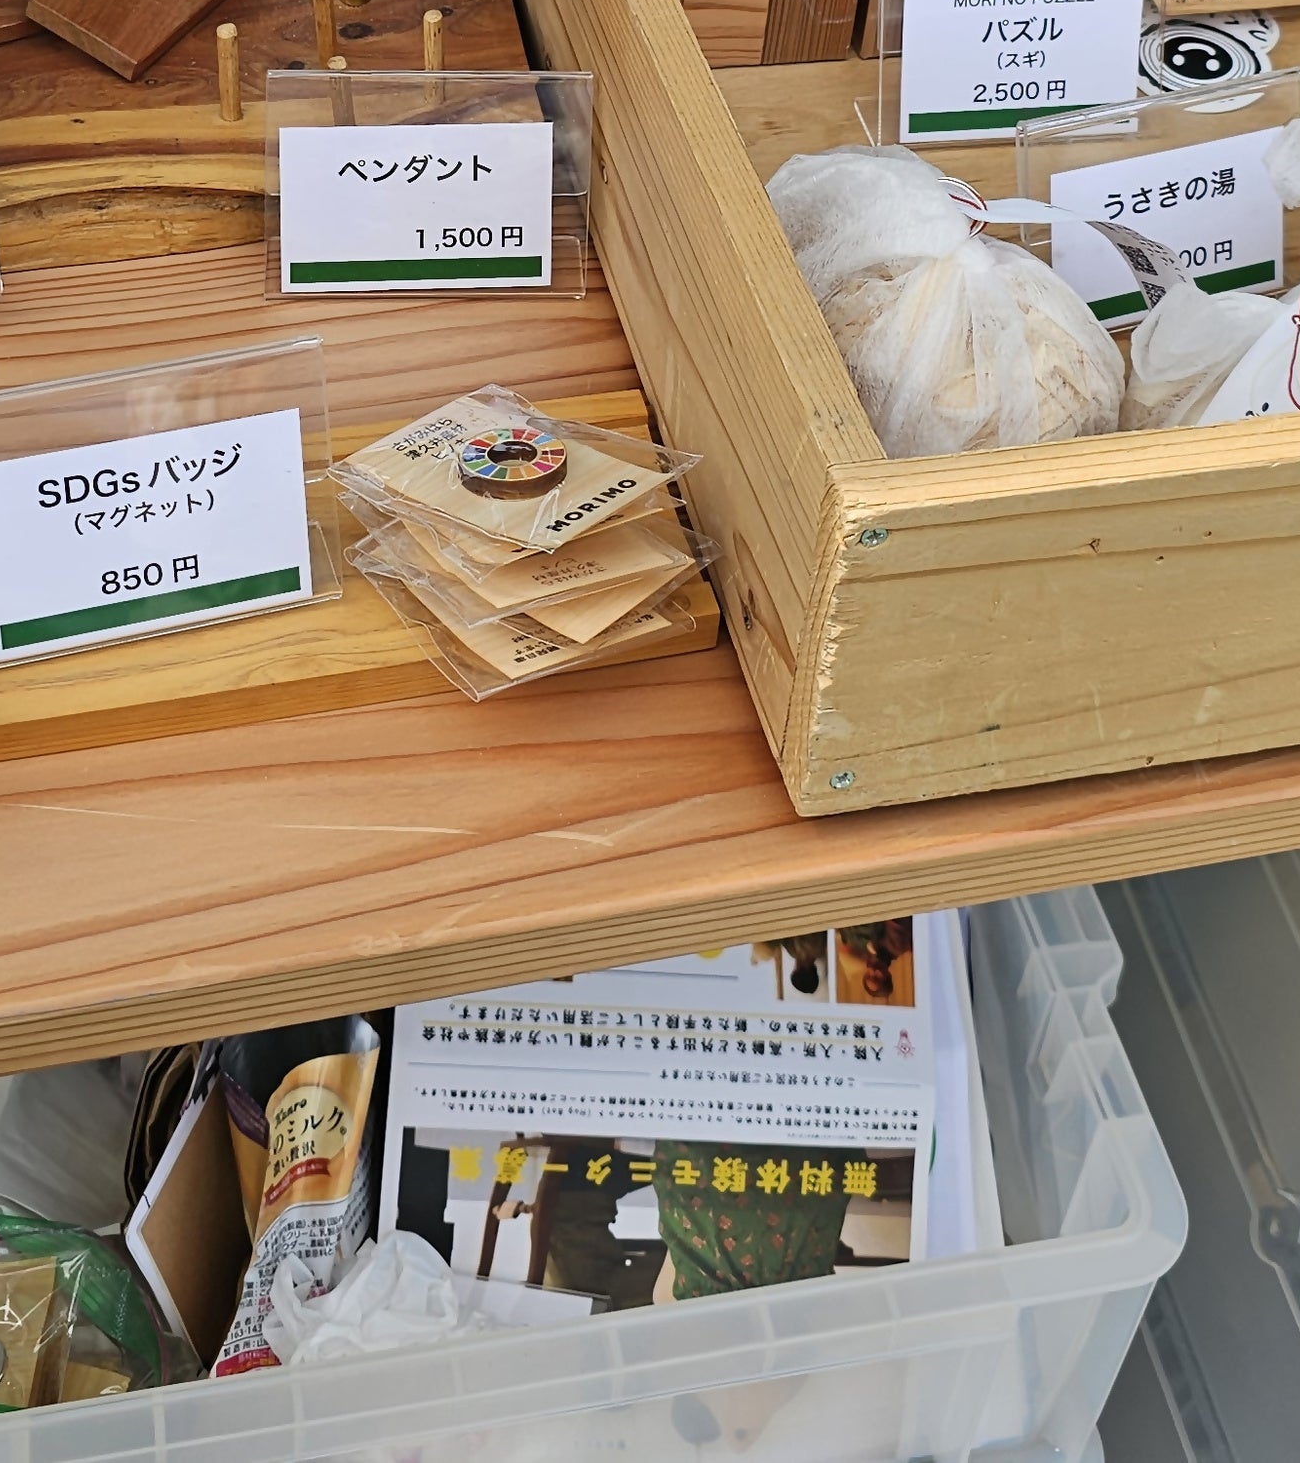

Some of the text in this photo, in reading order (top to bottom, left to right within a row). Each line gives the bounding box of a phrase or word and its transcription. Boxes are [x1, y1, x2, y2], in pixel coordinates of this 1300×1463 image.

[981, 16, 1064, 44] パズル
[996, 50, 1047, 70] (スギ)
[337, 153, 494, 184] ペンダント
[1103, 167, 1237, 221] うさきの湯
[73, 488, 216, 536] (マグネット)
[545, 477, 638, 534] MORIMO
[447, 1144, 878, 1199] 無料体験モニター募集
